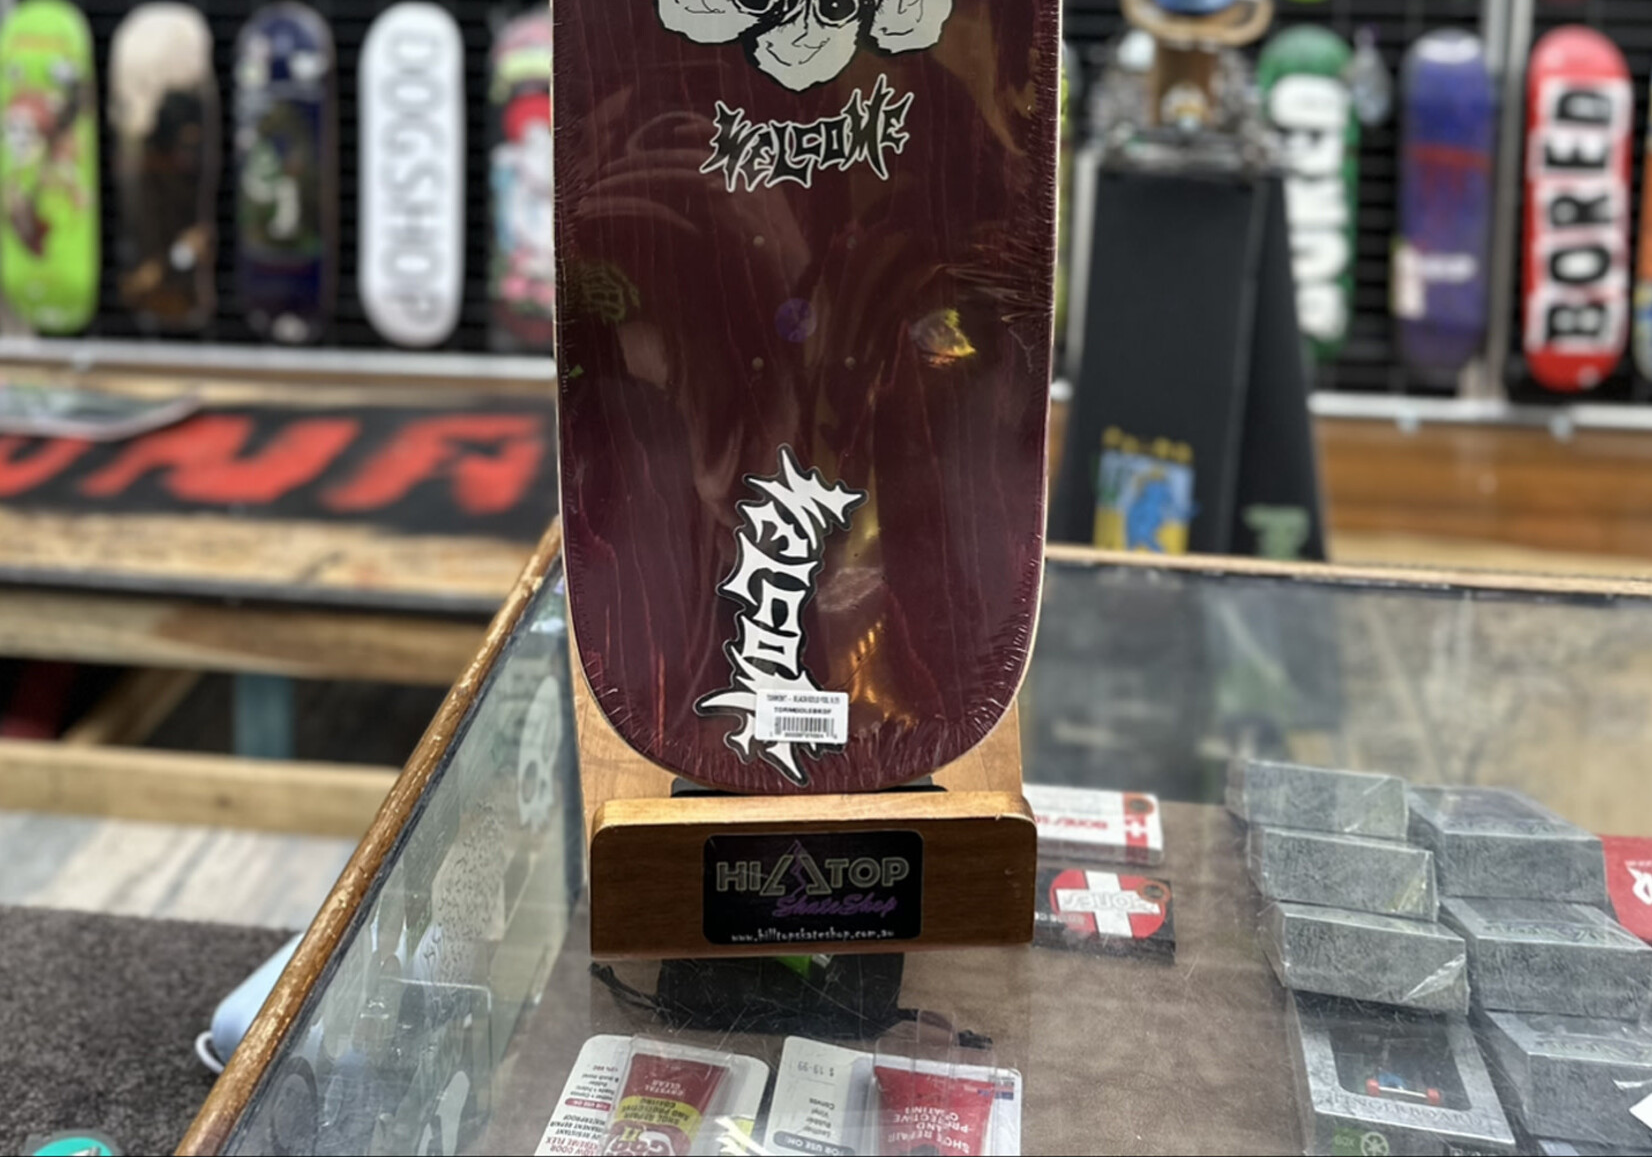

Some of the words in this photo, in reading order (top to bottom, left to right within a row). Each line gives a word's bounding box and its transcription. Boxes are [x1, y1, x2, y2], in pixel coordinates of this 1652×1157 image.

[699, 73, 915, 193] WELCOME
[1544, 89, 1613, 342] BORED
[731, 927, 894, 942] www.hilltopskateshop.com.au
[809, 1097, 835, 1110] Canvas
[811, 1107, 830, 1118] Vinyl
[806, 1116, 831, 1129] Rubber
[803, 1126, 831, 1138] Leather
[888, 1128, 933, 1144] REPAIR
[804, 1141, 824, 1153] USE
